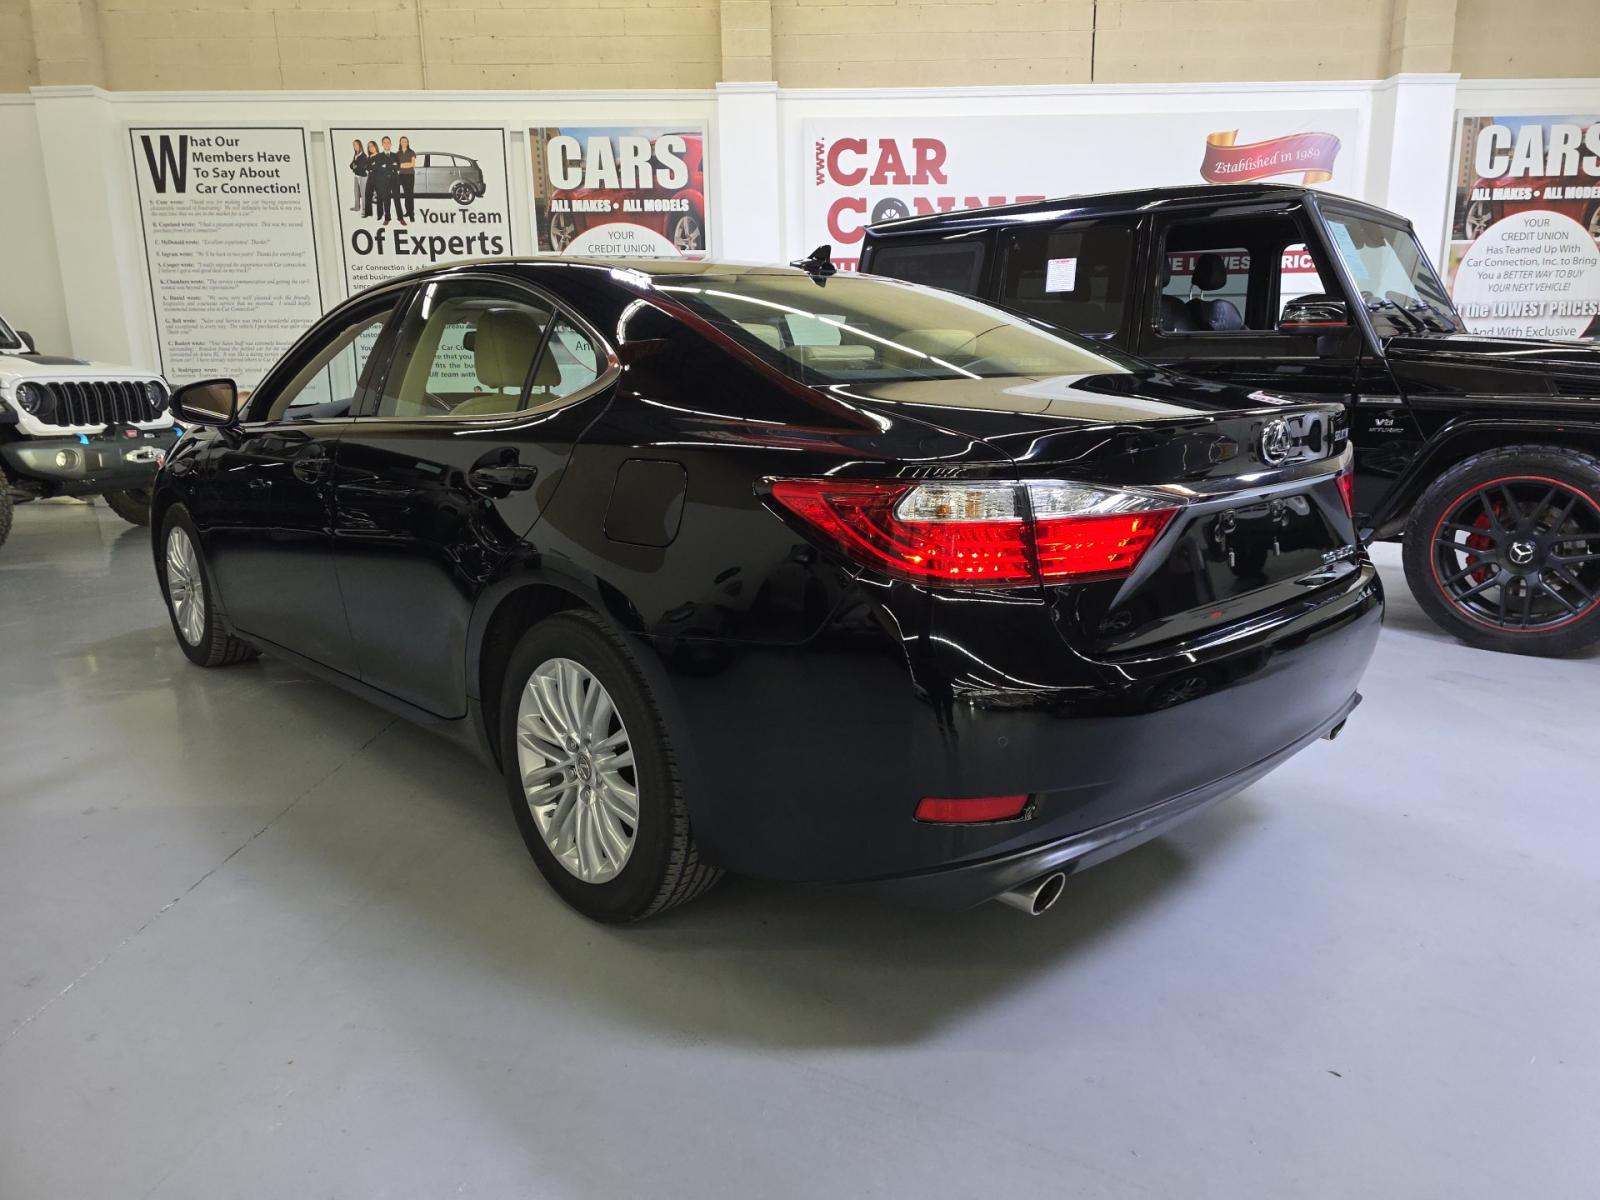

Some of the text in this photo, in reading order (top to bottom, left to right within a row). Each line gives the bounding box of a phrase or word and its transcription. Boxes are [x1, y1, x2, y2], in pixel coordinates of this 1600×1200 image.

[215, 135, 240, 147] Our
[192, 152, 291, 163] Members Have
[547, 135, 689, 190] CARS
[827, 137, 948, 187] CAR
[1213, 151, 1280, 174] Established
[1280, 151, 1293, 161] in
[193, 167, 280, 180] To Say About
[196, 183, 301, 194] Car Connection!
[1471, 187, 1532, 200] ALL MAKES
[1543, 186, 1600, 200] ALL MODE
[551, 200, 612, 212] ALL MAKES
[623, 199, 690, 212] ALL MODELS
[419, 208, 502, 224] Your Team
[1524, 218, 1550, 227] YOUR
[608, 231, 634, 240] YOUR
[1501, 231, 1569, 241] CREDIT UNION
[351, 228, 504, 262] Of Experts
[588, 244, 656, 253] CREDIT UNION
[1487, 244, 1581, 256] Has Teamed Up With
[1467, 259, 1482, 267] Car
[1561, 258, 1570, 266] to
[1573, 256, 1597, 267] Bring
[1478, 272, 1494, 280] You
[1503, 271, 1533, 280] BETTER
[1535, 270, 1552, 279] WAY
[1555, 270, 1566, 278] TO
[1567, 270, 1585, 278] BUY
[1488, 283, 1571, 292] YOUR NEXT VEHICLE!
[1467, 303, 1489, 318] the
[1491, 301, 1547, 318] LOWEST
[1472, 326, 1577, 337] And With Exclusive
